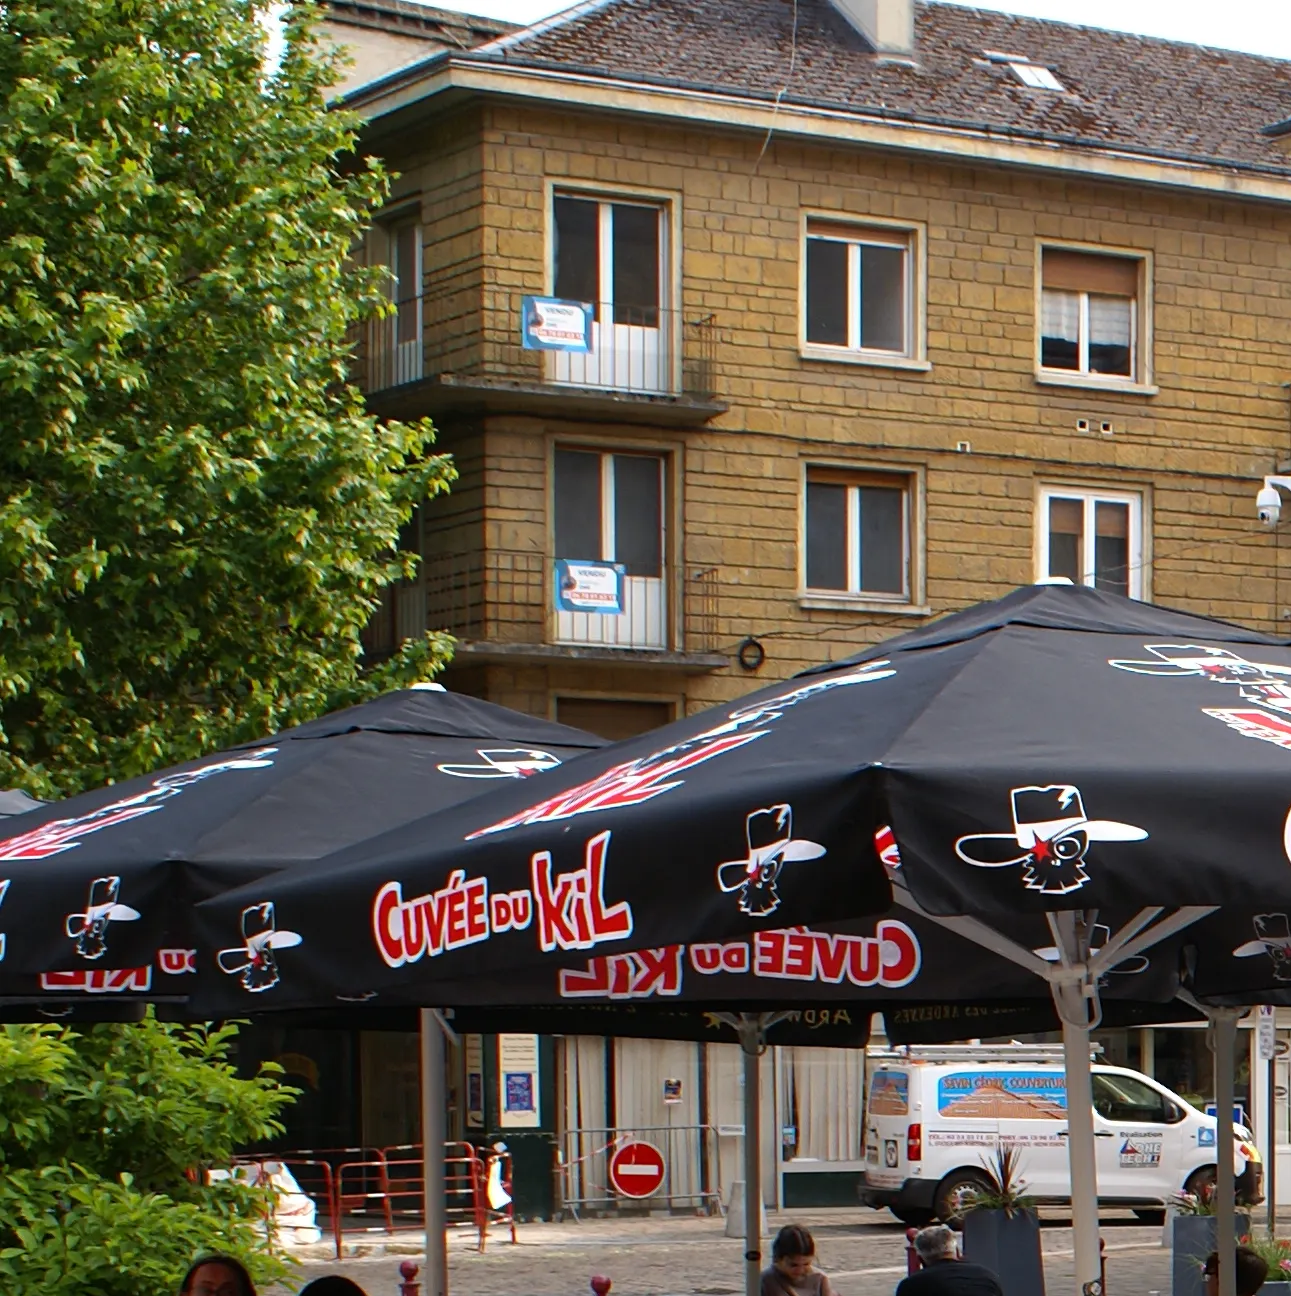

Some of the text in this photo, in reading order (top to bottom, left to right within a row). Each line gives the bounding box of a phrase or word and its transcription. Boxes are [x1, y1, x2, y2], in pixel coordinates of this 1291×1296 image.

[374, 869, 489, 968] CUVÉE
[491, 890, 532, 932] DU
[1011, 1077, 1068, 1089] COUVERTUR
